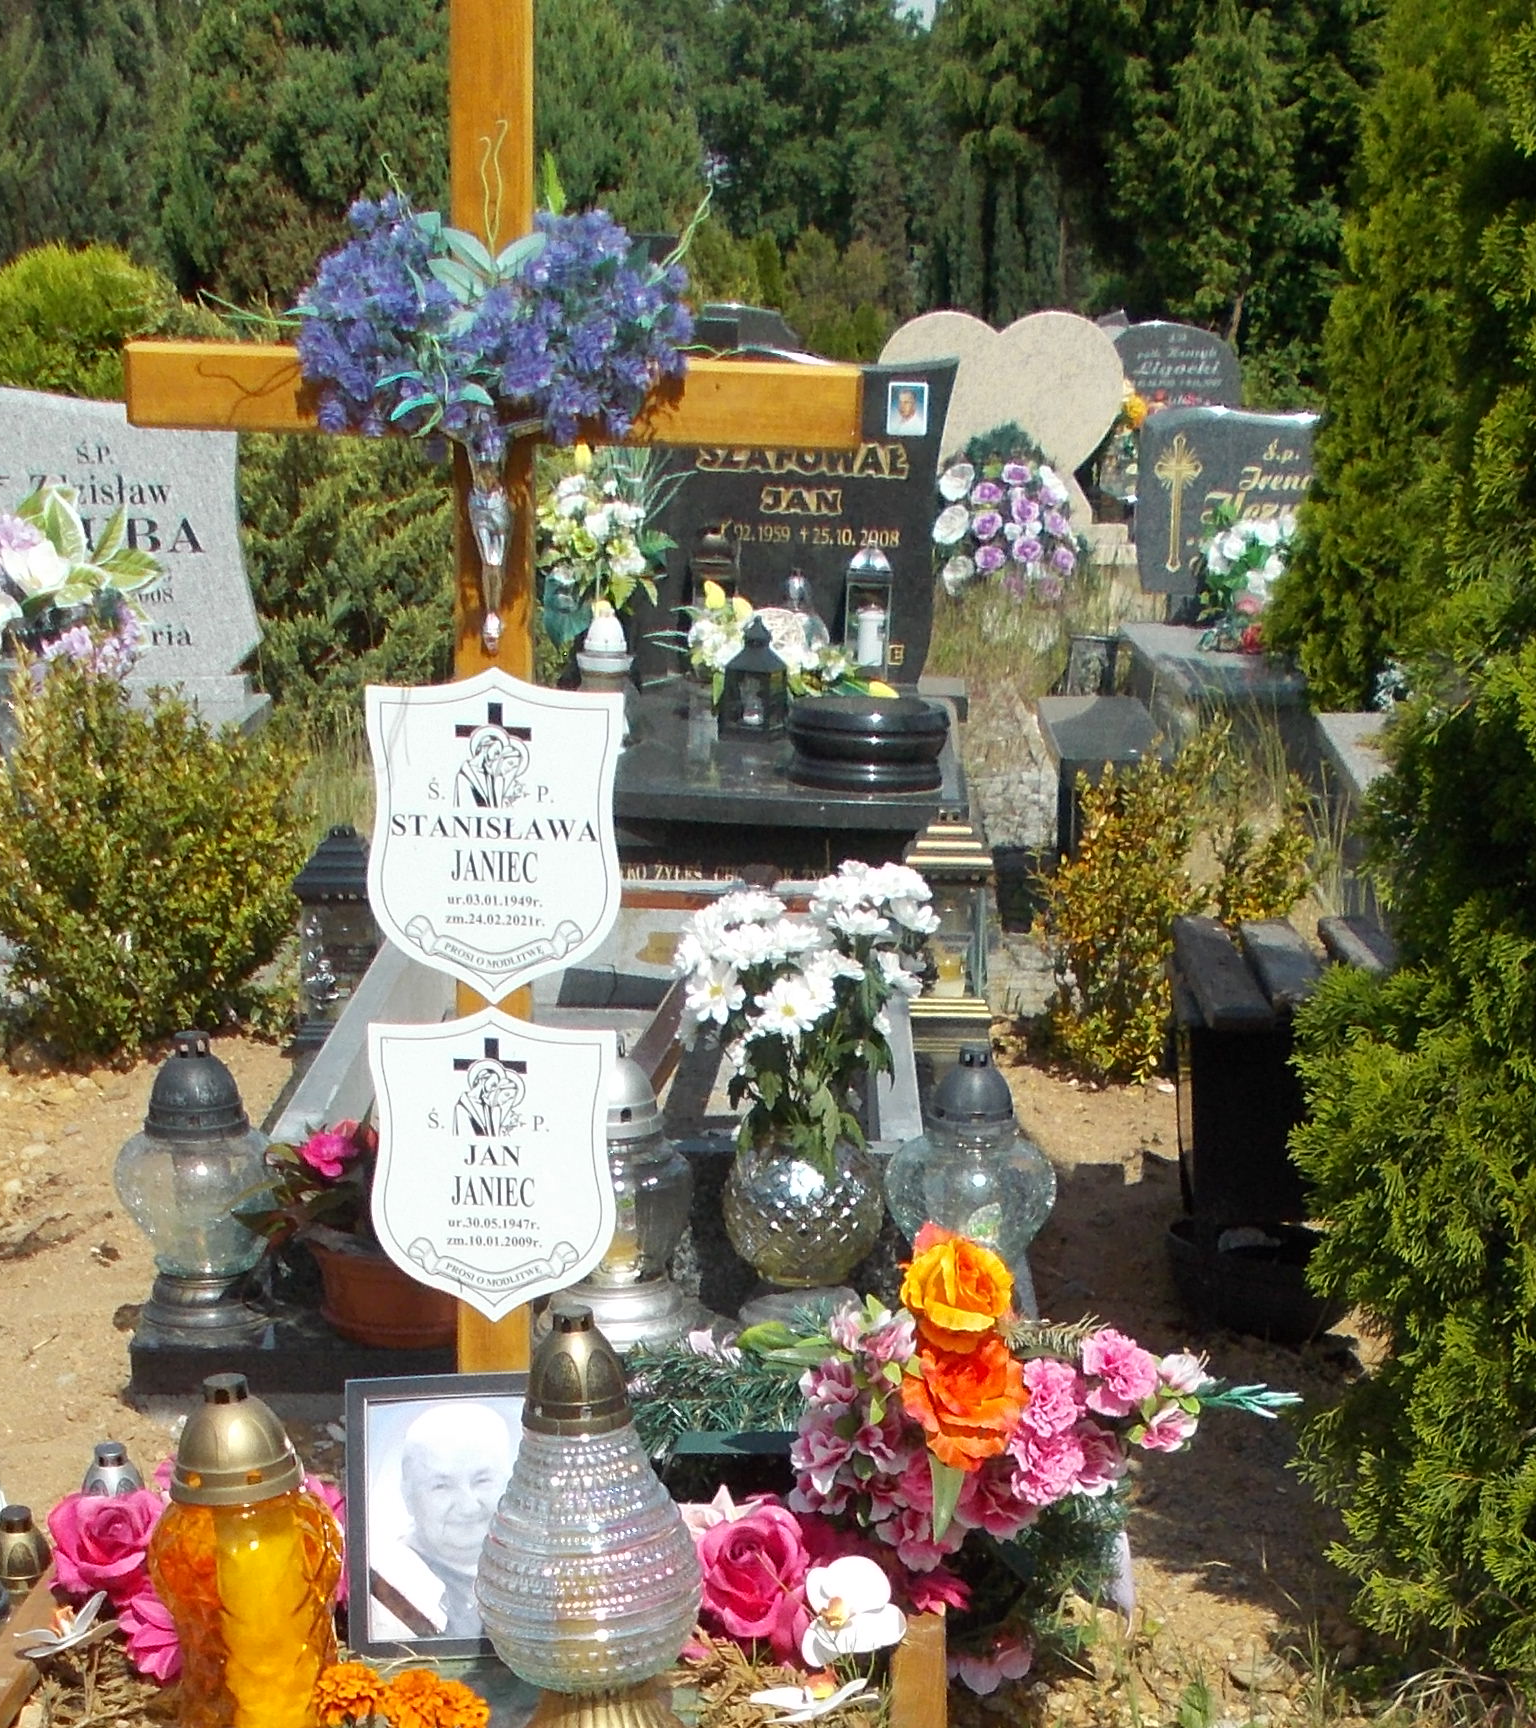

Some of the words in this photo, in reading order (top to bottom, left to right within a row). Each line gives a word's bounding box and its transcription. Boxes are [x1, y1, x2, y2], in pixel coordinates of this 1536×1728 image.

[29, 474, 172, 505] Zzisław
[759, 486, 843, 516] JAN
[391, 813, 599, 843] STANISŁAWA
[451, 849, 539, 884] JANIEC
[445, 913, 545, 928] zm.24.02.2021r.
[444, 942, 475, 964] PROSI
[476, 955, 486, 967] O
[486, 945, 545, 969] MODLITWĘ
[464, 1144, 522, 1167] JAN
[451, 1176, 536, 1208] JANIEC
[446, 1235, 543, 1249] zm.10.01.2009r.
[444, 1262, 475, 1282] PROSI
[476, 1275, 486, 1286] O
[486, 1264, 543, 1288] MODLITWĘ
